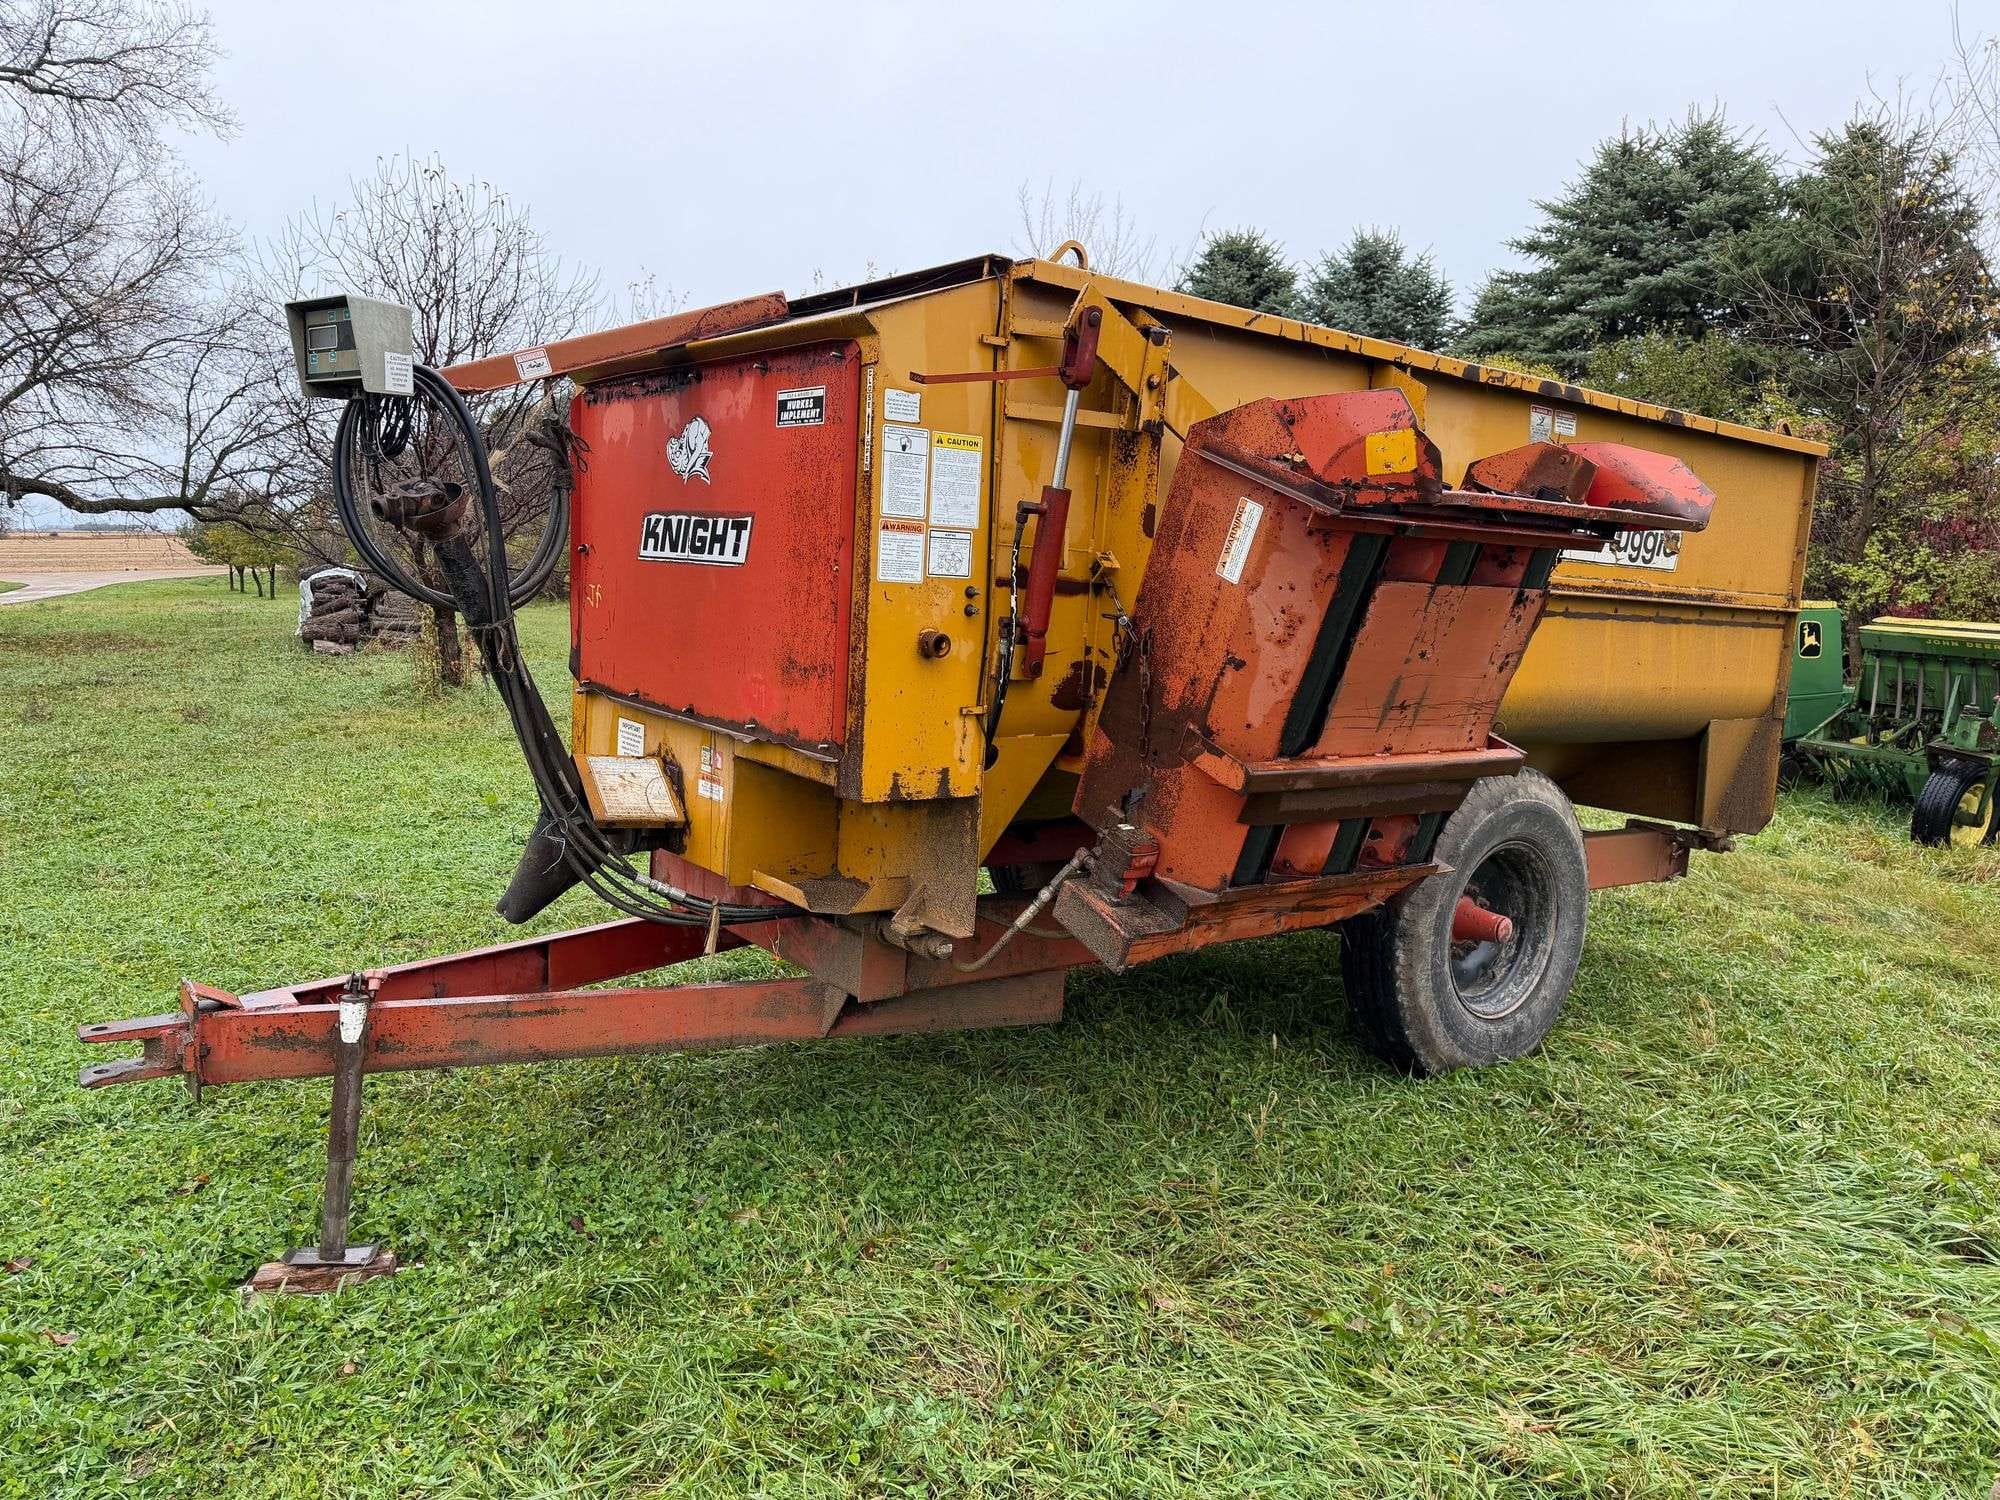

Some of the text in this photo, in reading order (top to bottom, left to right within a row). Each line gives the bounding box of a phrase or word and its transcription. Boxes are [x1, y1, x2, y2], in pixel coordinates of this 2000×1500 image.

[780, 408, 820, 421] IMPLEMENT
[947, 438, 979, 447] CAUTION
[889, 523, 922, 533] WARNING
[1224, 505, 1246, 554] WARNING
[643, 517, 748, 556] KNIGHT
[1926, 639, 1959, 647] JOHN
